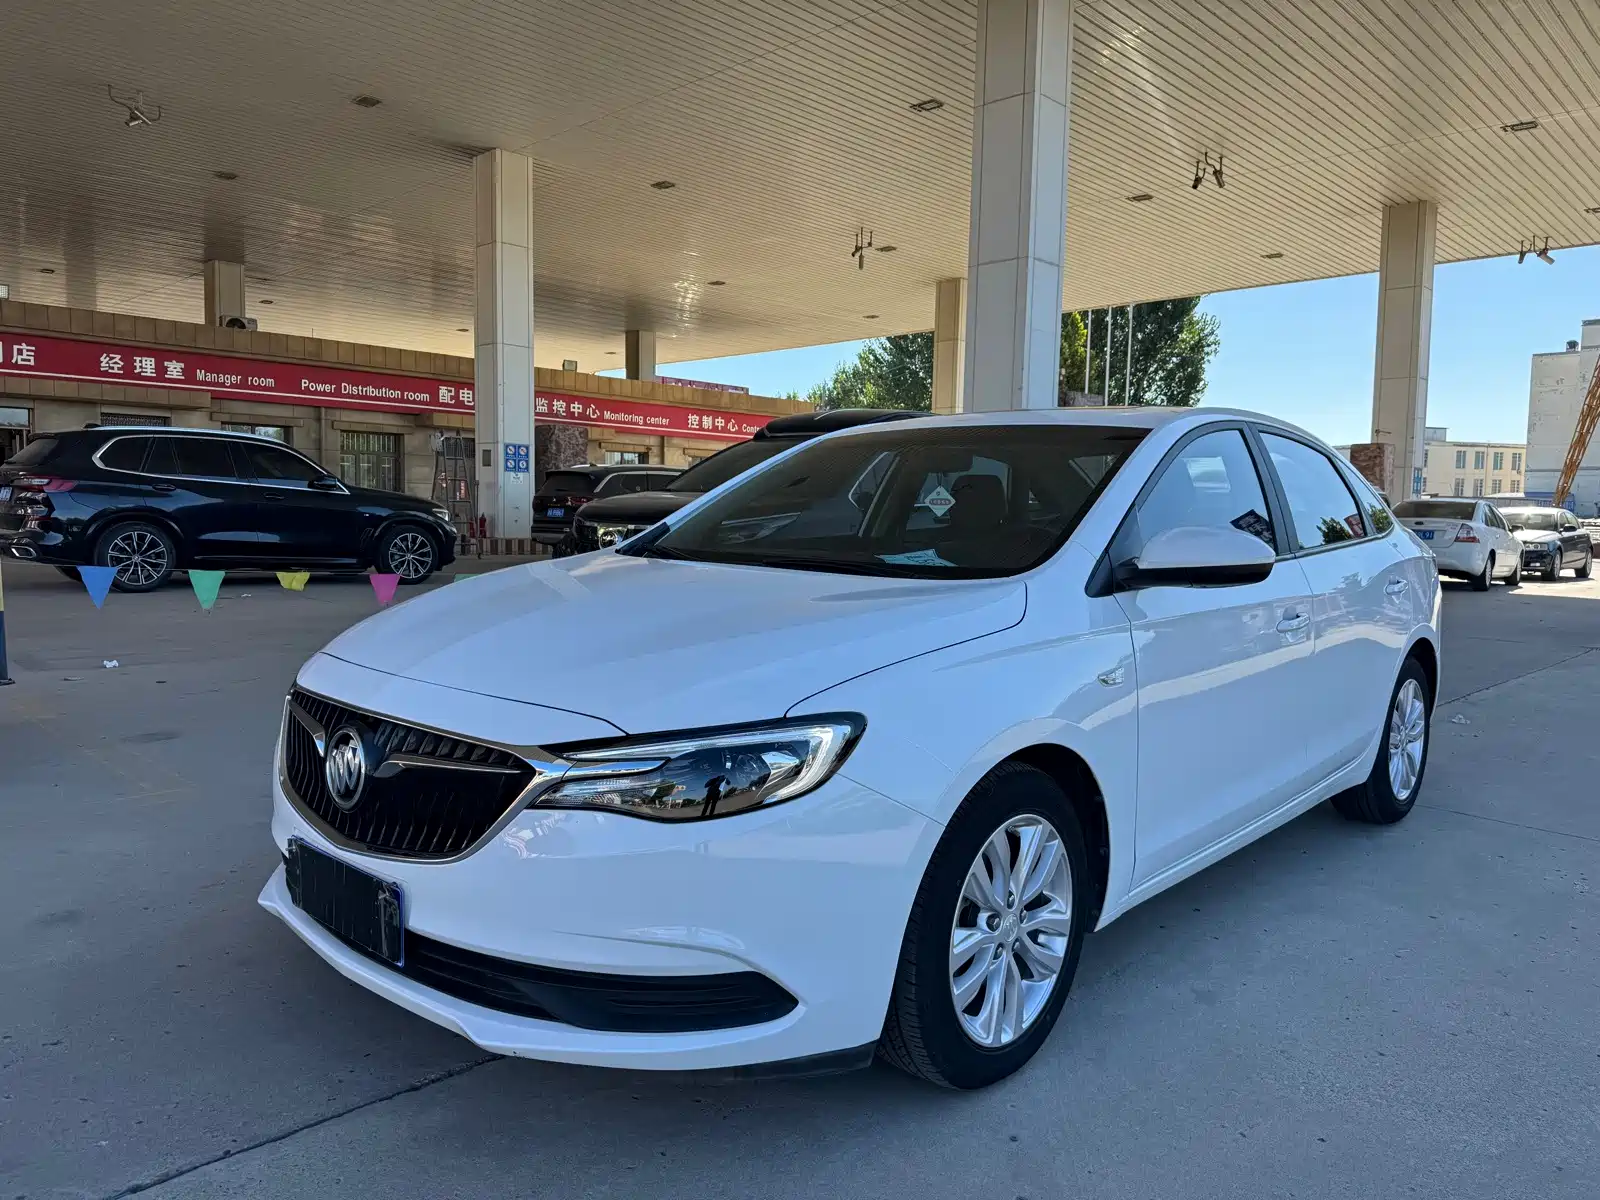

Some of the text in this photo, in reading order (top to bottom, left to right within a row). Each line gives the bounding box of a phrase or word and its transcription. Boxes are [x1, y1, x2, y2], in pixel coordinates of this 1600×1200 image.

[0, 341, 36, 366] 店
[100, 353, 275, 387] 经理室 Manager room
[301, 379, 336, 393] Power
[341, 382, 401, 399] Distribution
[404, 391, 430, 402] room
[535, 398, 670, 426] 监控中心 Monitoring center
[688, 413, 739, 432] 控制中心
